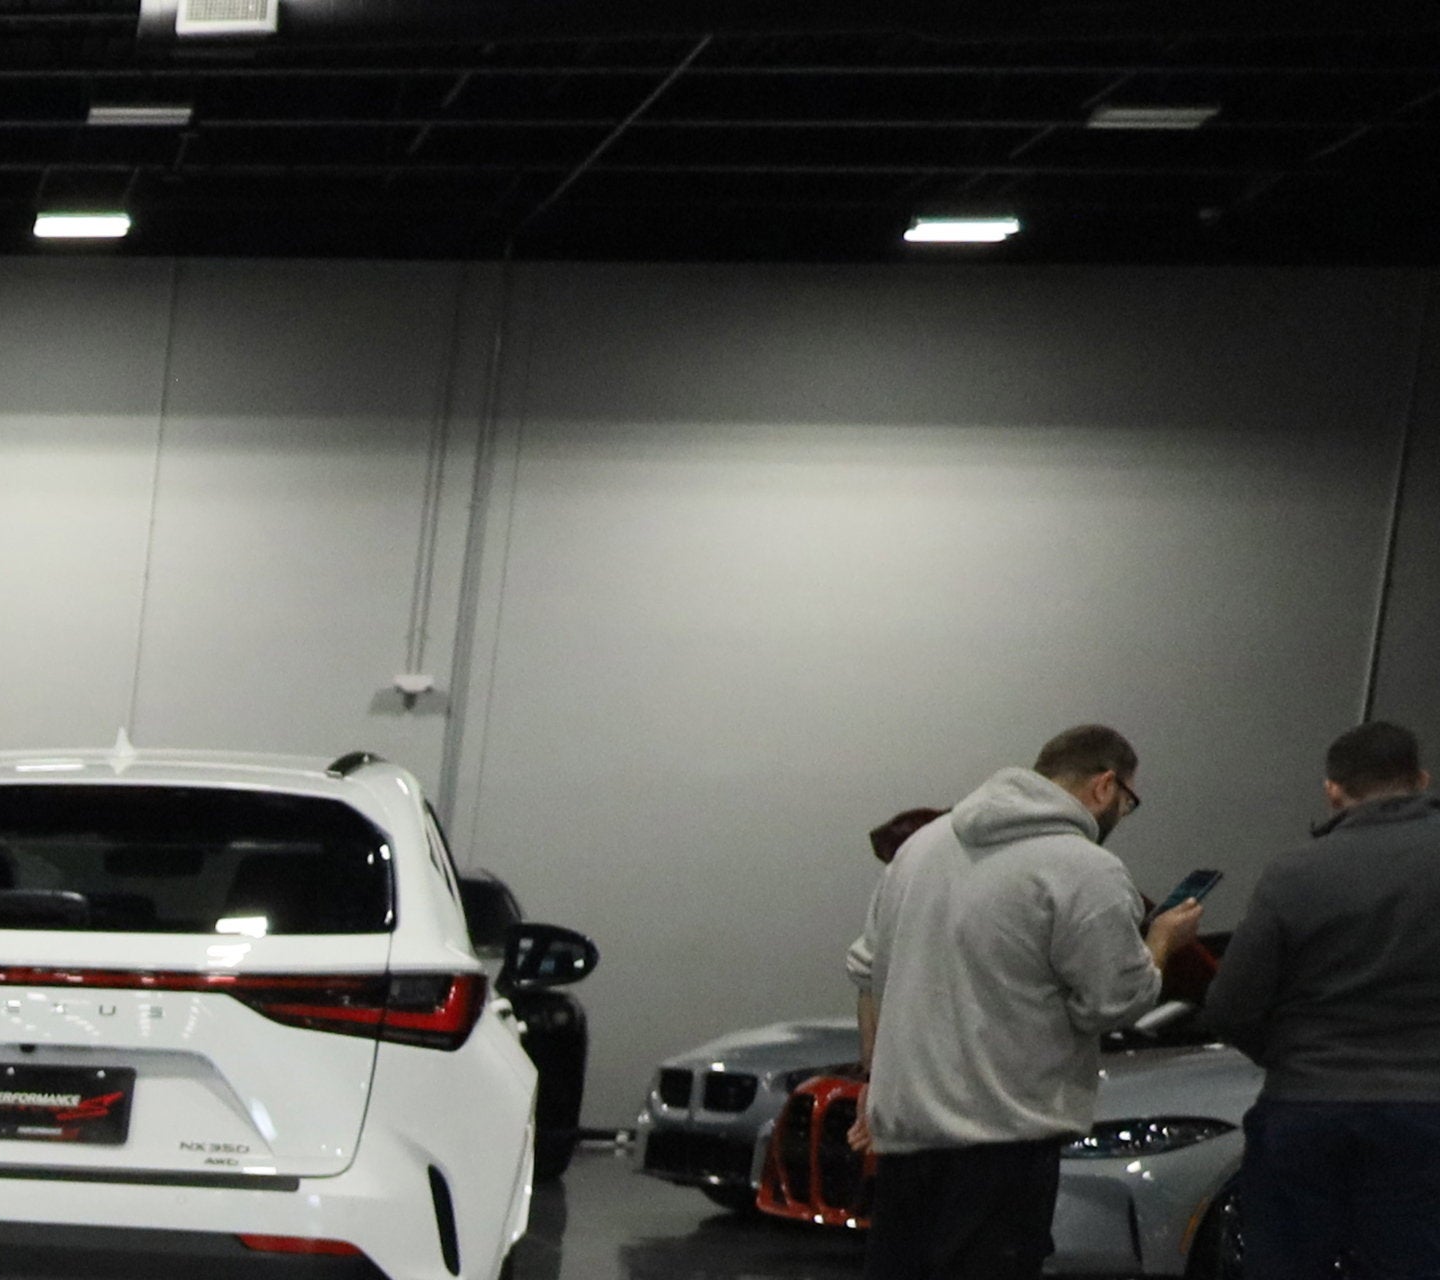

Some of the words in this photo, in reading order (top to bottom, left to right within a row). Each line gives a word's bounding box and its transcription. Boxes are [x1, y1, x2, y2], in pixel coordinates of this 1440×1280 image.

[179, 1141, 206, 1152] NX
[209, 1142, 251, 1154] 350
[204, 1157, 239, 1166] AWD
